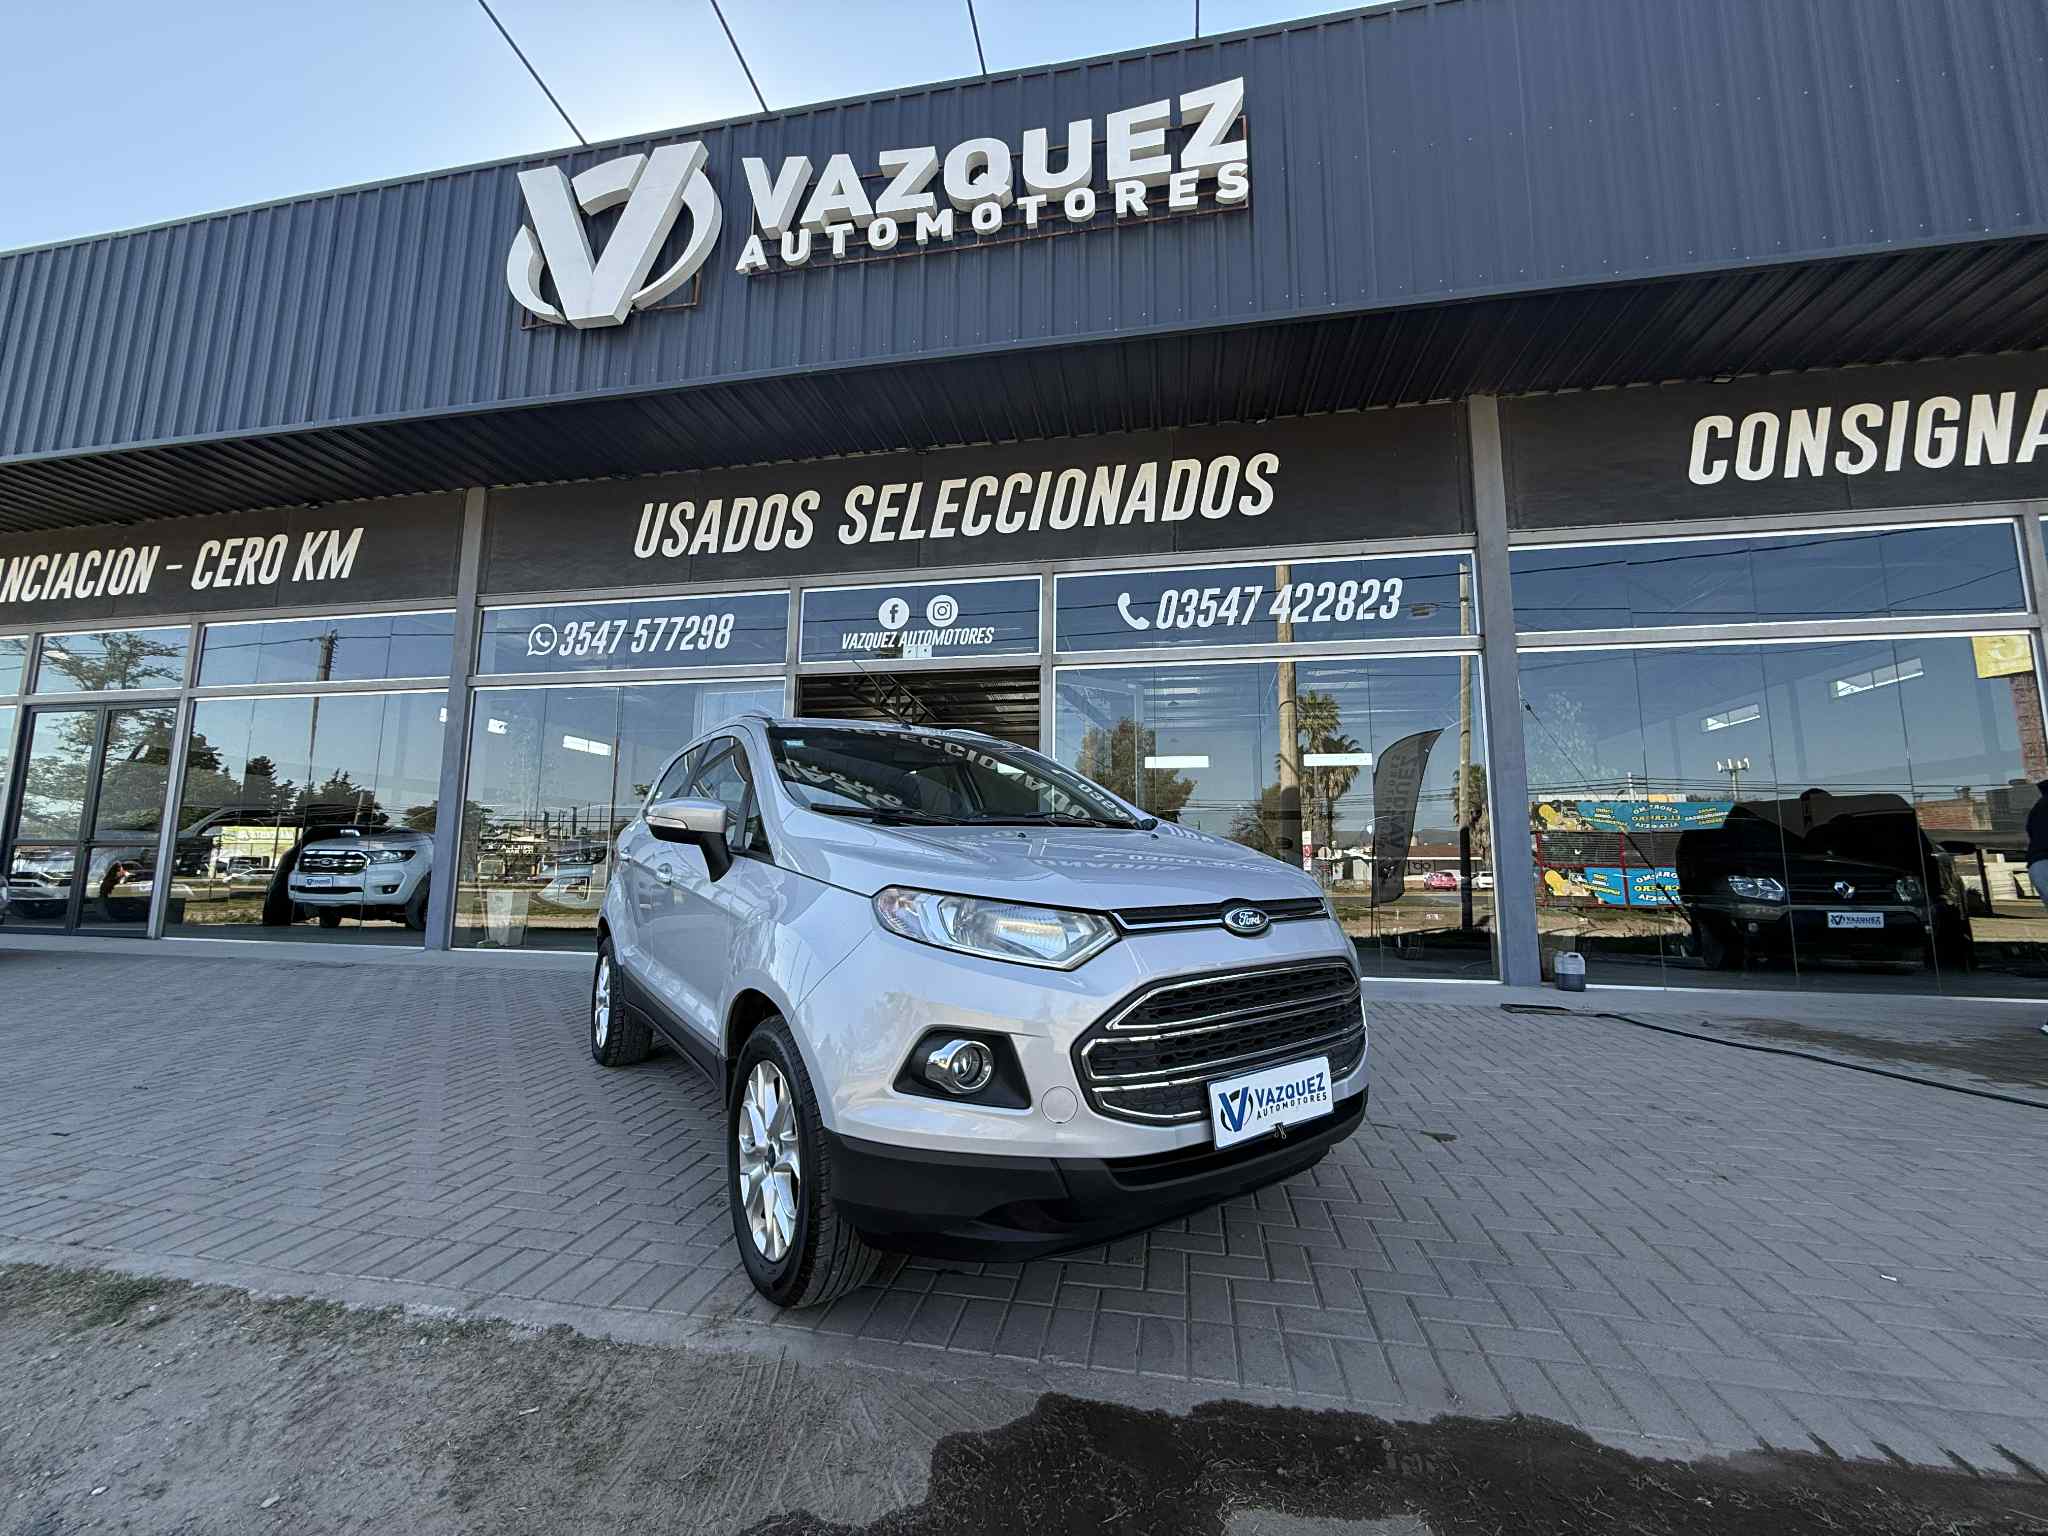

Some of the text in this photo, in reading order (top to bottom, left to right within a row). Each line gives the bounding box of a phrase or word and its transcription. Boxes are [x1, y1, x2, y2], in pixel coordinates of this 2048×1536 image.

[742, 77, 1246, 240] VAZQUEZ
[736, 163, 1248, 273] AUTOMOTORES
[633, 452, 1280, 559] USADOS SELECCIONADOS
[190, 533, 289, 591] CERO
[292, 527, 364, 583] KM
[1156, 577, 1403, 630] 03547 422823
[558, 613, 735, 656] 3547 577298
[841, 626, 995, 651] VAZQUEZ AUTOMOTORES
[1239, 911, 1260, 925] Ford
[1254, 1072, 1325, 1109] VAZQUEZ
[1256, 1092, 1327, 1120] AUTOMOTORES
